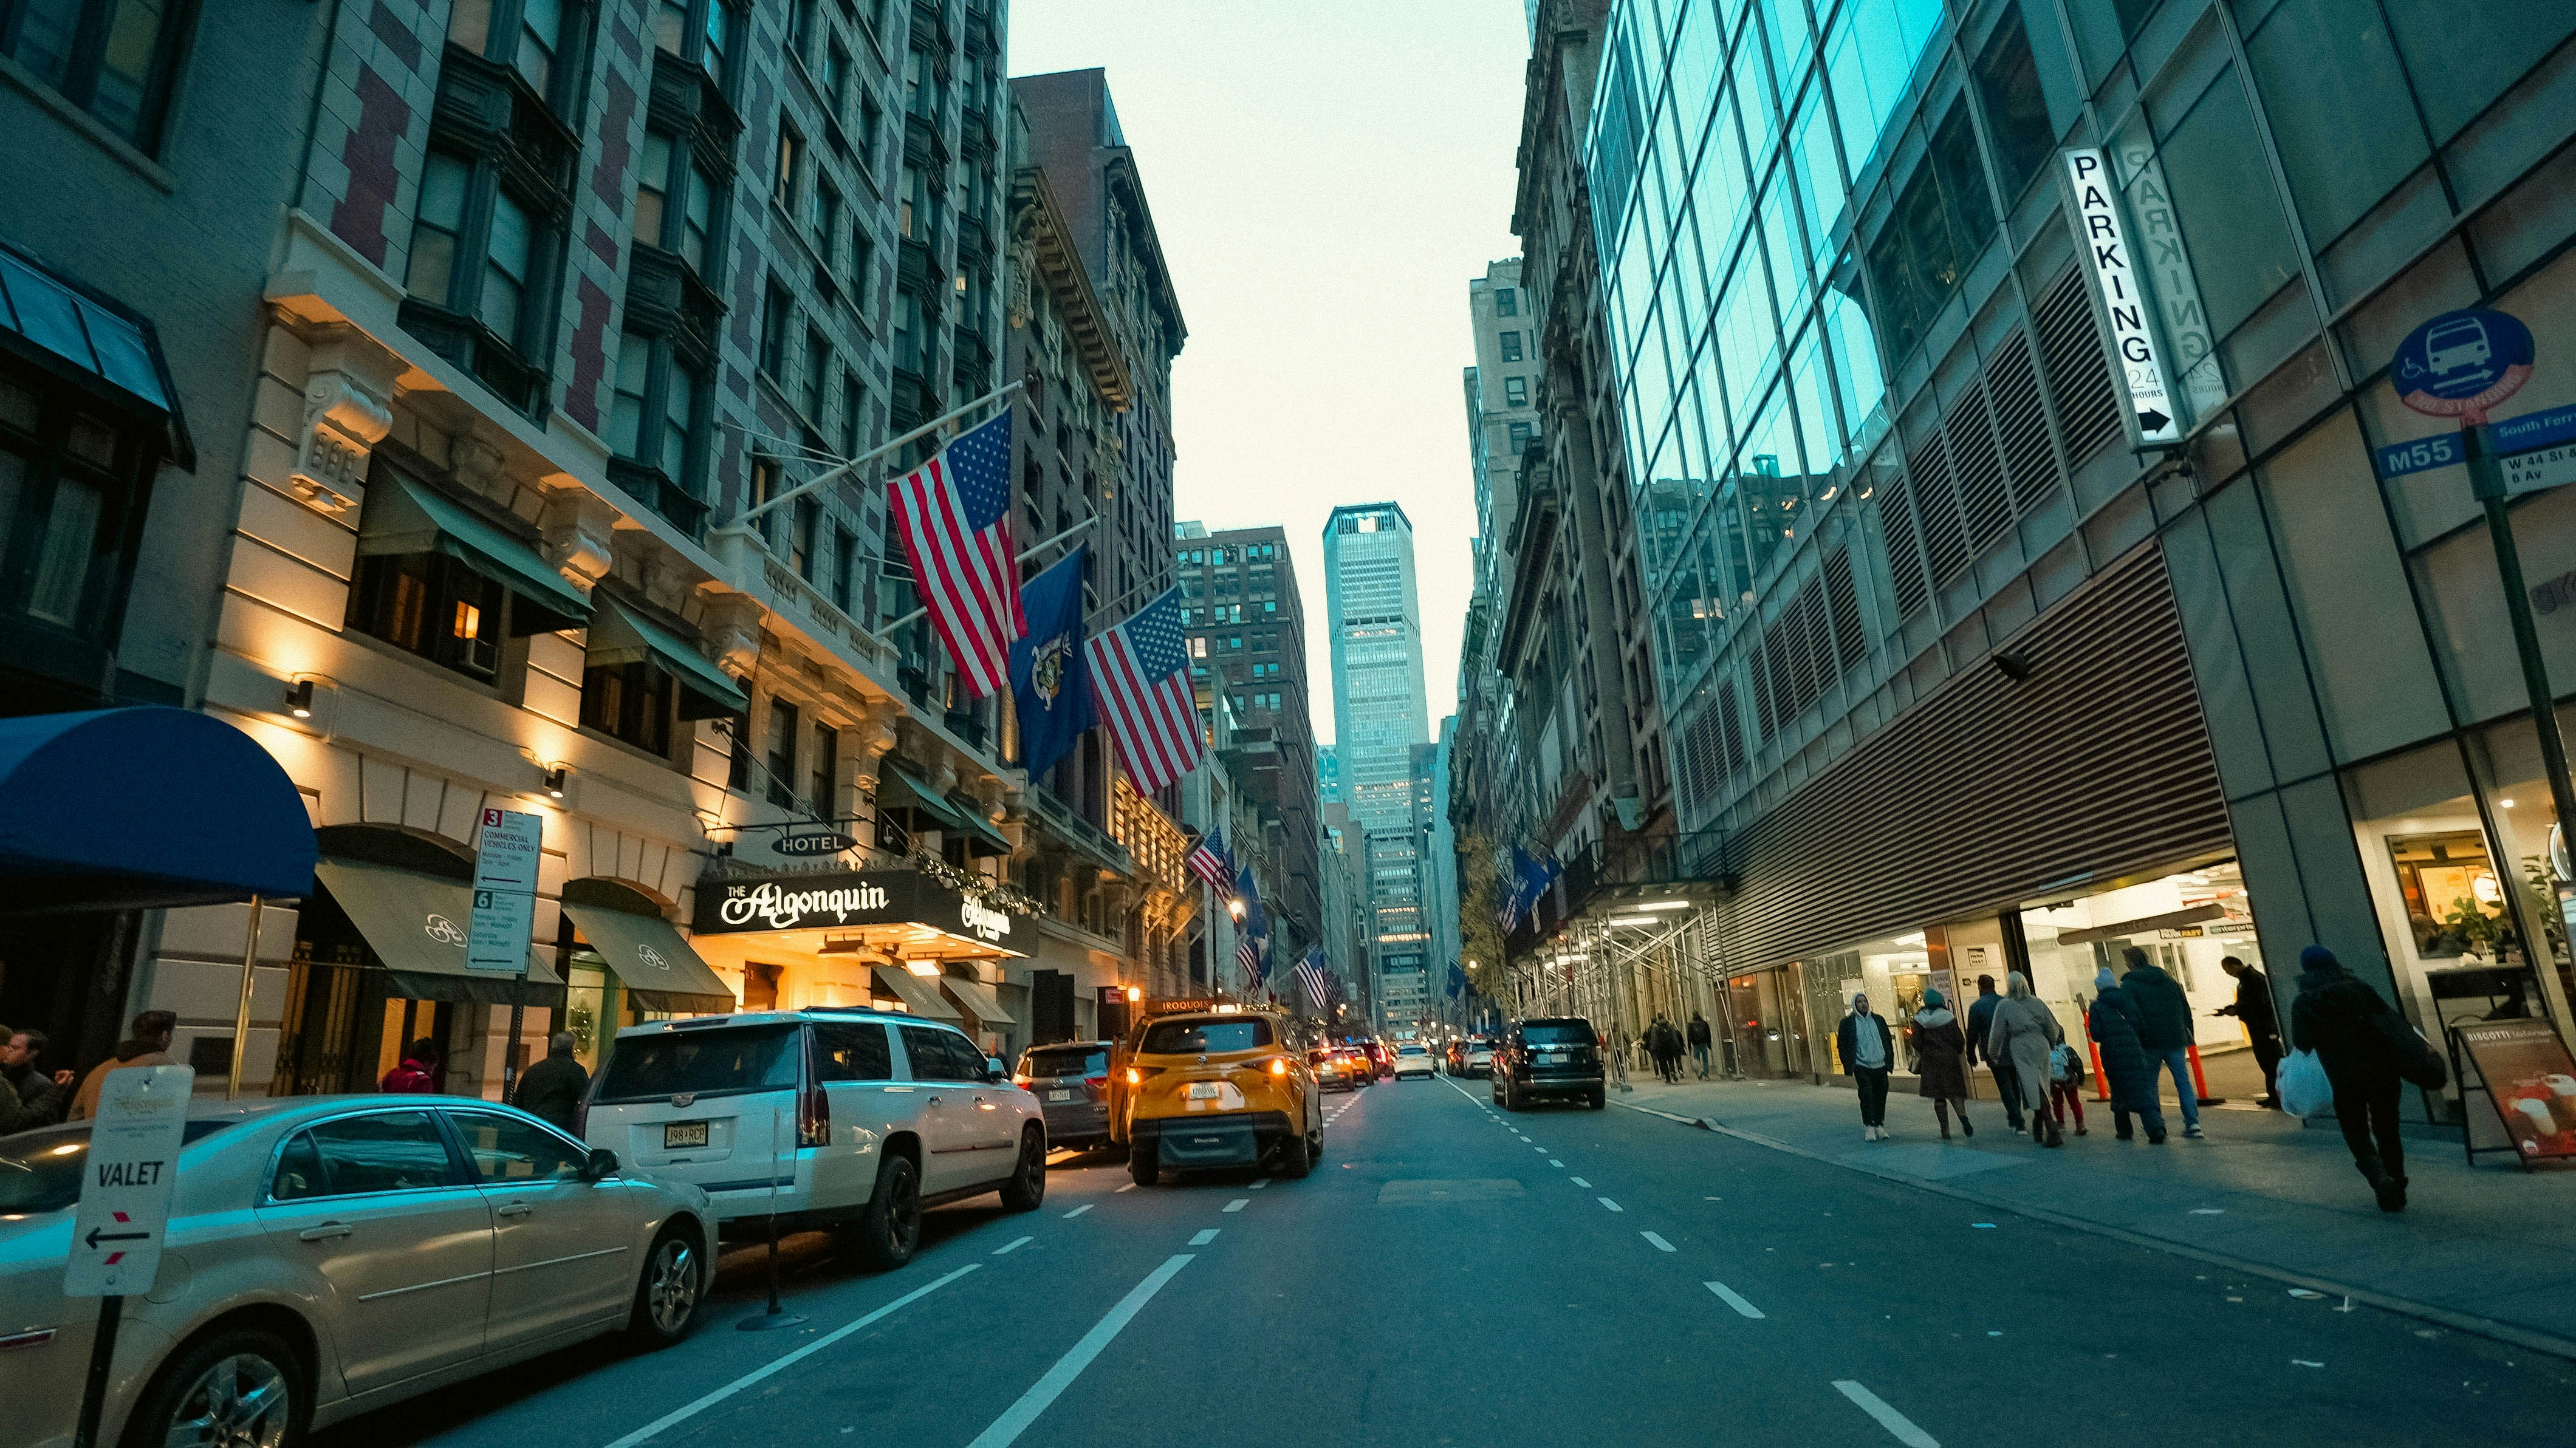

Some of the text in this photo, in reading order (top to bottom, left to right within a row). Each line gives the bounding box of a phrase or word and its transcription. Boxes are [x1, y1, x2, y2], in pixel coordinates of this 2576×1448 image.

[2074, 156, 2152, 363] PARKING
[2128, 368, 2160, 390] 24
[2132, 389, 2163, 400] HOURS
[2499, 420, 2541, 438] South
[2388, 438, 2453, 473] M55
[2508, 458, 2521, 470] W
[2527, 454, 2544, 466] 44
[2550, 450, 2564, 462] St
[2526, 471, 2541, 481] Av
[487, 810, 499, 827] 3
[484, 830, 529, 844] COMMERCIAL
[782, 836, 843, 852] HOTEL
[483, 839, 535, 853] VEHICLES ONLY
[727, 885, 747, 898] THE
[478, 892, 489, 908] 6
[721, 881, 890, 929] Algonquin
[1163, 1000, 1210, 1011] IROQUOIS
[98, 1161, 165, 1187] VALET
